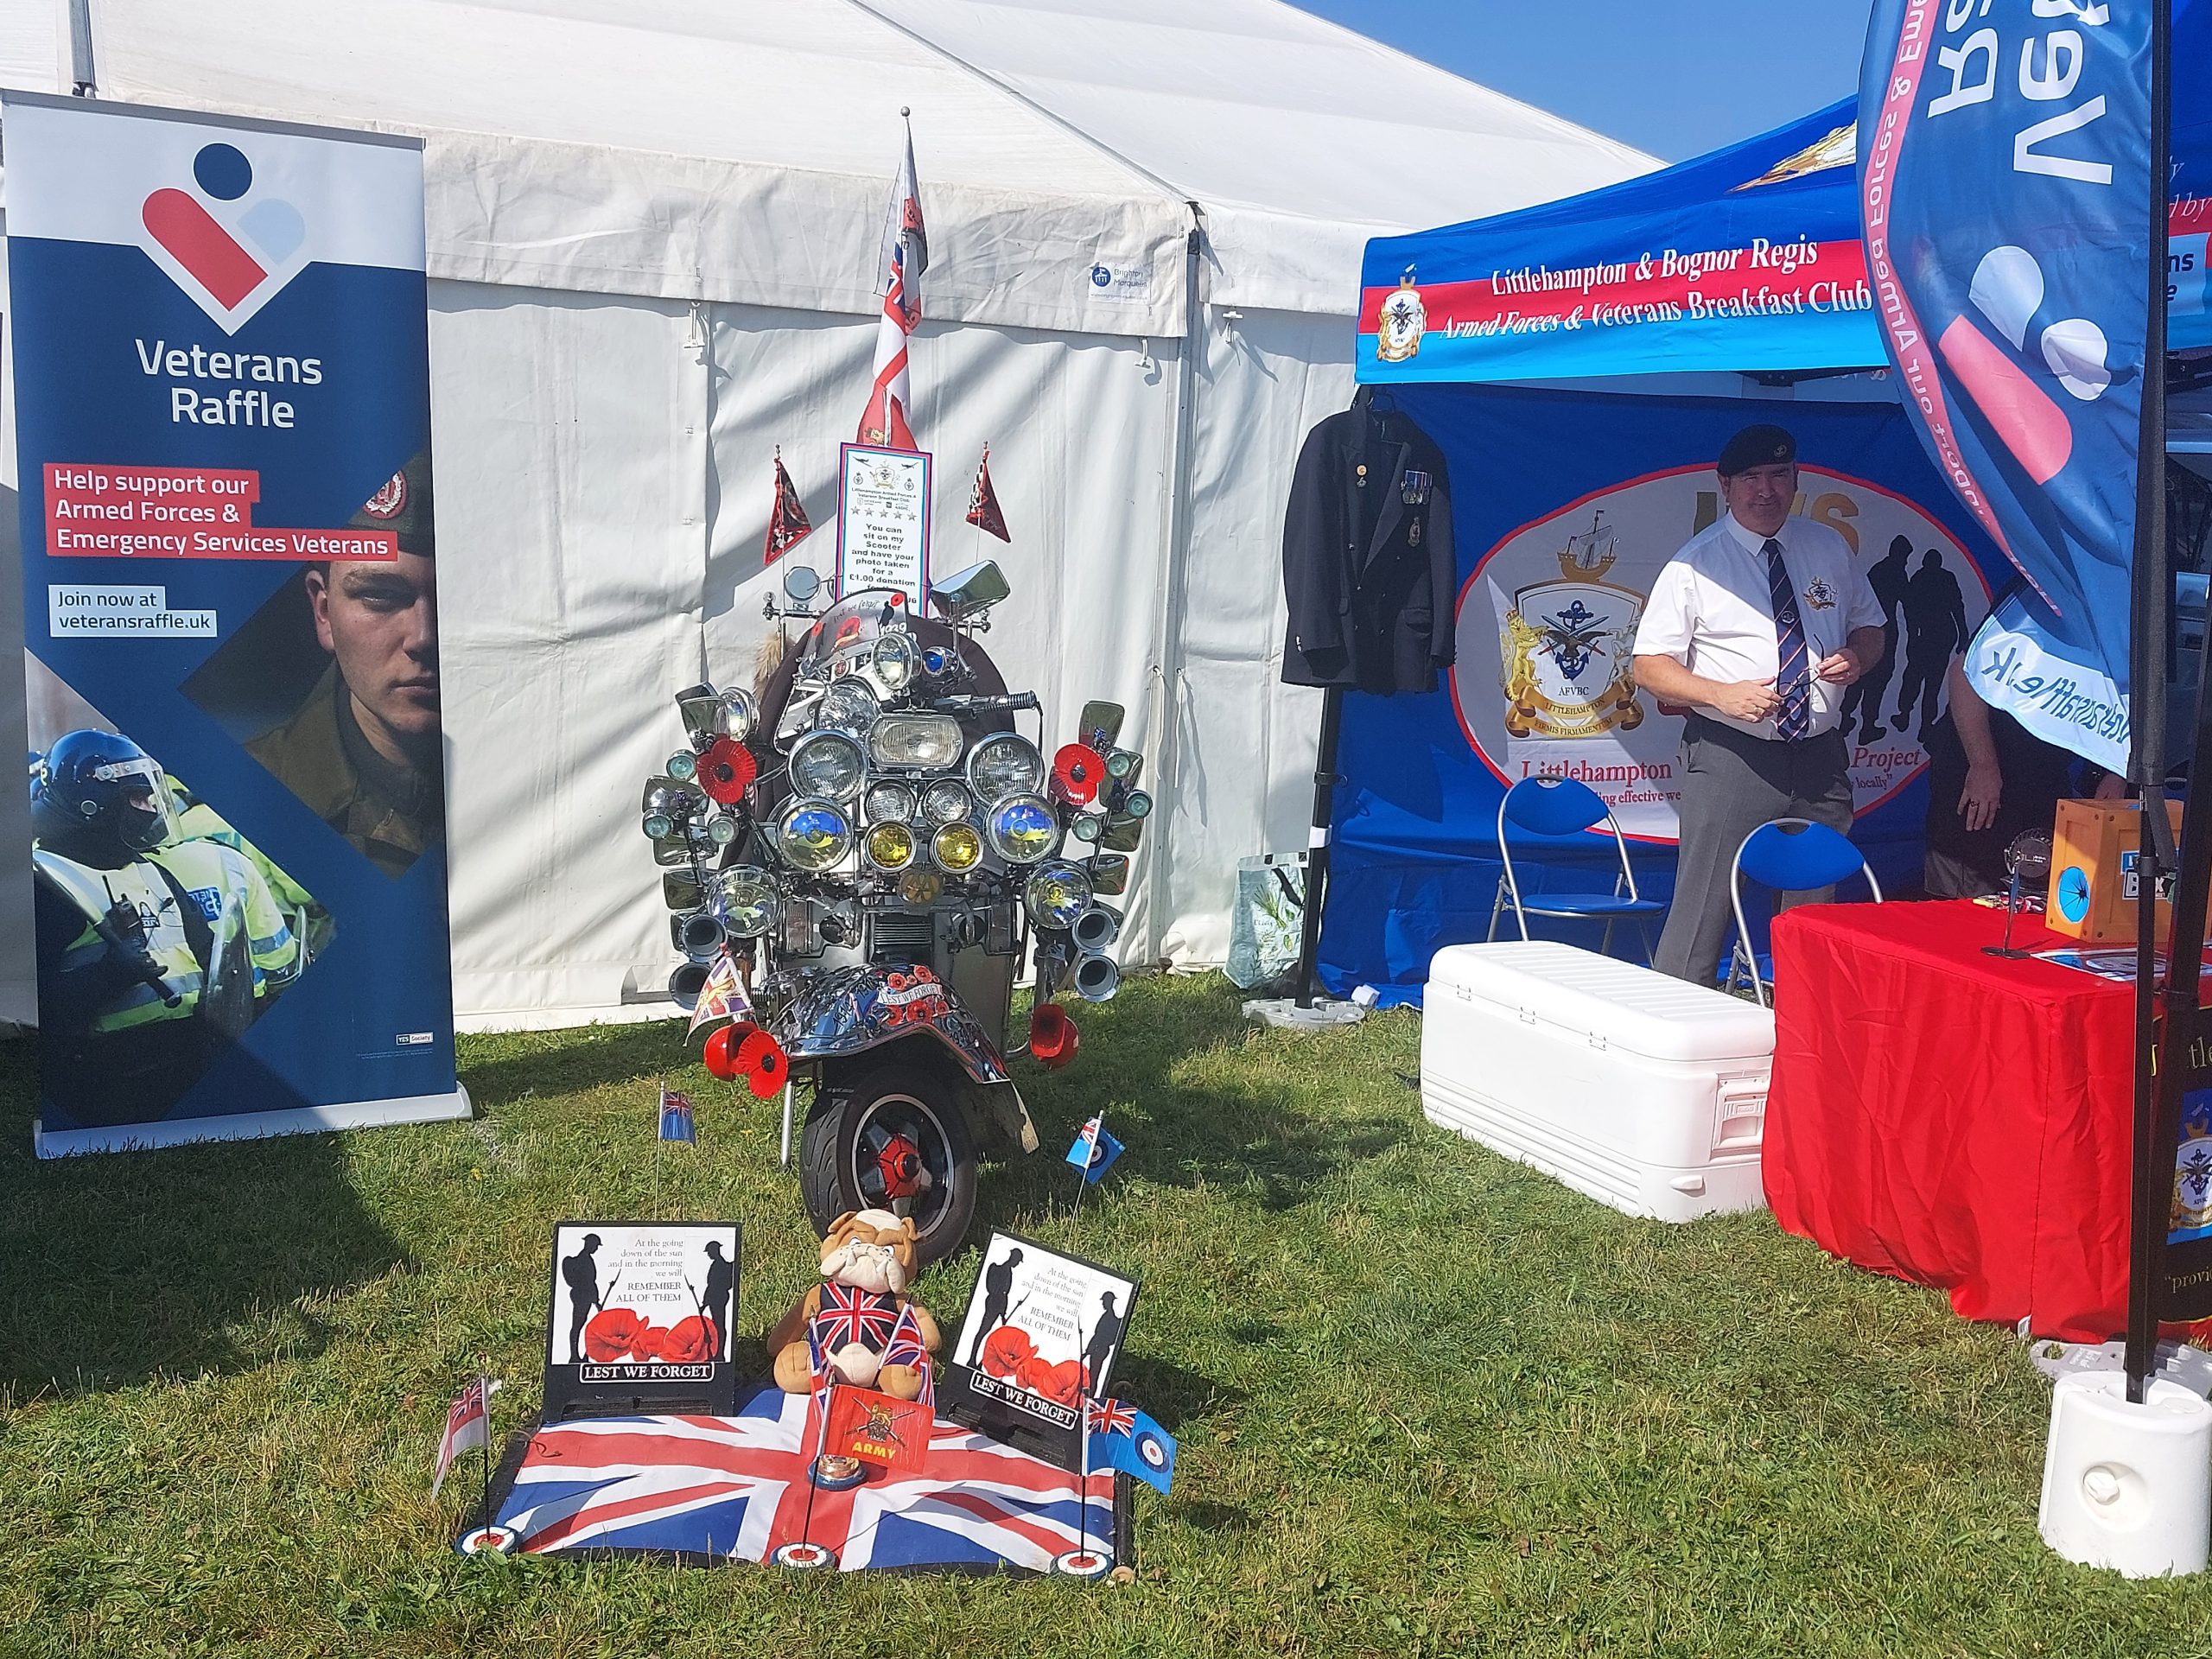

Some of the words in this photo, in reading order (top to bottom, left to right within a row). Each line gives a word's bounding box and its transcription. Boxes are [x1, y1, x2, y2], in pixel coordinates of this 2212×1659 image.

[1491, 259, 1627, 296] Littlehampton
[1634, 251, 1655, 280] &
[1660, 247, 1743, 283] Bognor
[1749, 233, 1819, 275] Regis
[1439, 312, 1502, 339] Armed
[1500, 311, 1561, 336] Forces
[1564, 305, 1585, 330] &
[1591, 302, 1682, 328] Veterans
[1688, 286, 1805, 320] Breakfast
[1808, 279, 1872, 313] Club
[136, 339, 322, 385] Veterans
[172, 387, 295, 428] Raffle
[54, 469, 108, 493] Help
[115, 472, 206, 497] support
[212, 478, 249, 494] our
[55, 499, 133, 520] Armed
[141, 501, 215, 522] Forces
[222, 503, 240, 523] &
[57, 529, 187, 555] Emergency
[194, 532, 286, 553] Services
[292, 534, 388, 555] Veterans
[866, 541, 901, 550] Scooter
[855, 557, 881, 566] photo
[884, 560, 910, 569] taken
[849, 574, 874, 582] £1.00
[876, 576, 916, 587] donation
[58, 591, 90, 607] Join
[97, 594, 132, 607] now
[139, 593, 157, 607] at
[59, 613, 210, 629] veteransraffle.uk
[1559, 687, 1590, 696] AFVBC
[1544, 699, 1605, 715] LITTLEHAMPTON
[1851, 747, 1922, 773] Project
[1618, 790, 1663, 804] effective
[635, 1238, 645, 1247] At
[647, 1238, 660, 1247] the
[662, 1239, 683, 1248] going
[620, 1249, 642, 1257] down
[644, 1249, 652, 1257] of
[654, 1249, 667, 1257] the
[607, 1259, 622, 1268] and
[635, 1259, 648, 1268] the
[650, 1260, 683, 1268] morning
[669, 1268, 682, 1277] will
[1047, 1268, 1057, 1276] At
[1058, 1270, 1069, 1281] the
[1069, 1277, 1087, 1289] going
[627, 1281, 682, 1291] REMEMBER
[1034, 1273, 1052, 1286] down
[1060, 1282, 1071, 1293] the
[615, 1294, 634, 1302] ALL
[637, 1294, 650, 1302] OF
[652, 1293, 681, 1302] THEM
[1021, 1281, 1035, 1290] and
[1034, 1283, 1041, 1293] in
[1042, 1287, 1053, 1297] the
[1054, 1293, 1081, 1309] morning
[1030, 1306, 1074, 1330] REMEMBER
[1066, 1308, 1078, 1318] will
[1018, 1315, 1033, 1327] ALL
[1034, 1320, 1047, 1332] OF
[1047, 1325, 1071, 1341] THEM
[584, 1366, 620, 1379] LEST
[625, 1366, 648, 1378] WE
[650, 1365, 710, 1378] FORGET
[974, 1374, 1005, 1396] LEST
[1004, 1386, 1025, 1406] WE
[1024, 1394, 1075, 1425] FORGET
[852, 1441, 896, 1459] ARMY
